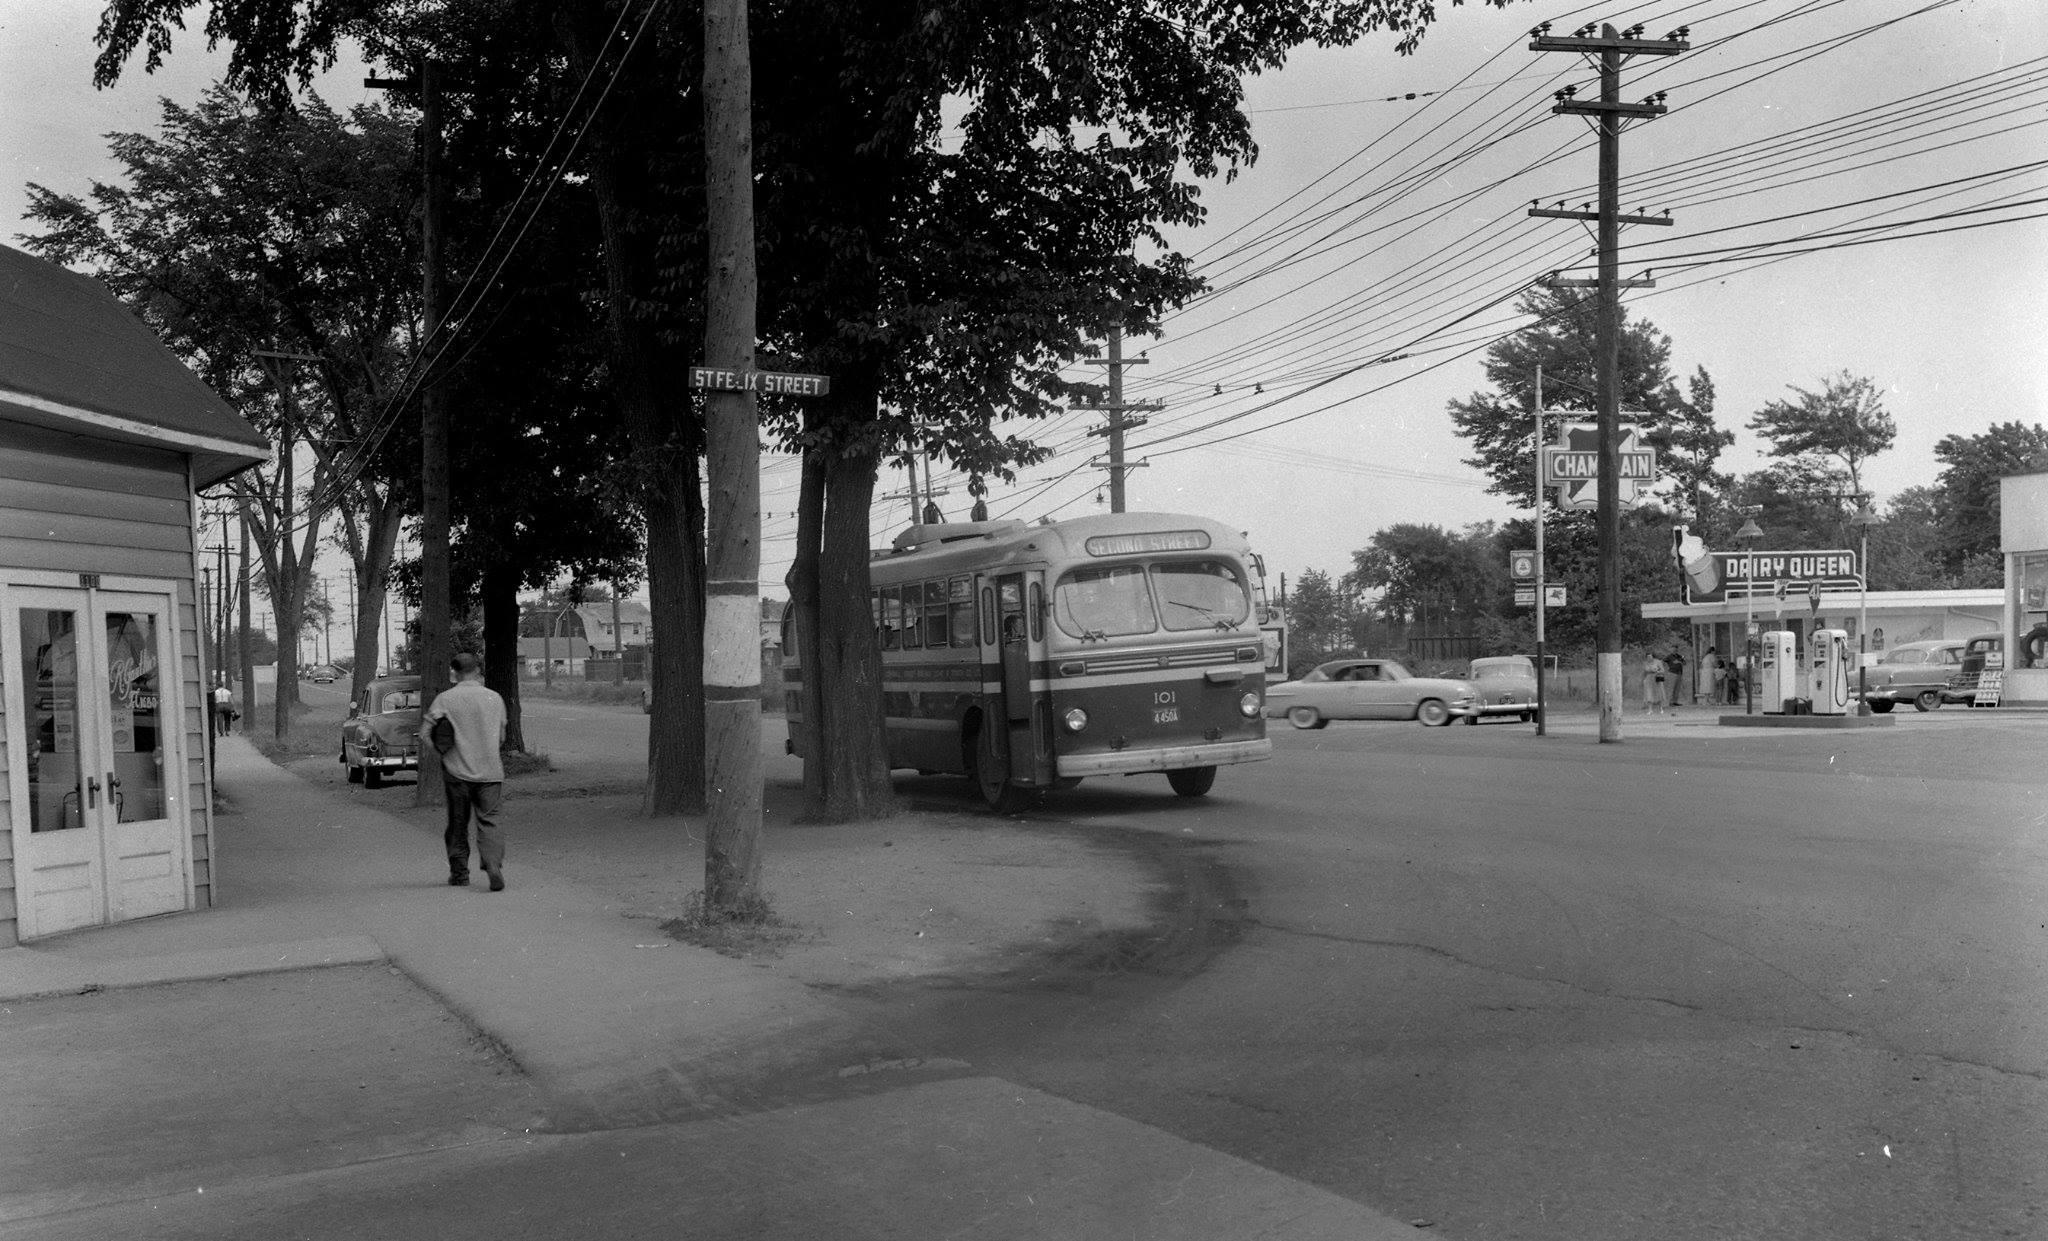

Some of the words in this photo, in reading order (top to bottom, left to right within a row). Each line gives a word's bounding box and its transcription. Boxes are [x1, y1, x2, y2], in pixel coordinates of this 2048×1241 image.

[765, 374, 821, 395] STREET
[1553, 454, 1649, 477] CHAMAIN
[1089, 537, 1143, 556] SECOND
[1150, 534, 1200, 551] STREET
[1726, 557, 1785, 578] DAIRY
[1790, 556, 1850, 578] QUEEN
[1154, 691, 1175, 704] 101
